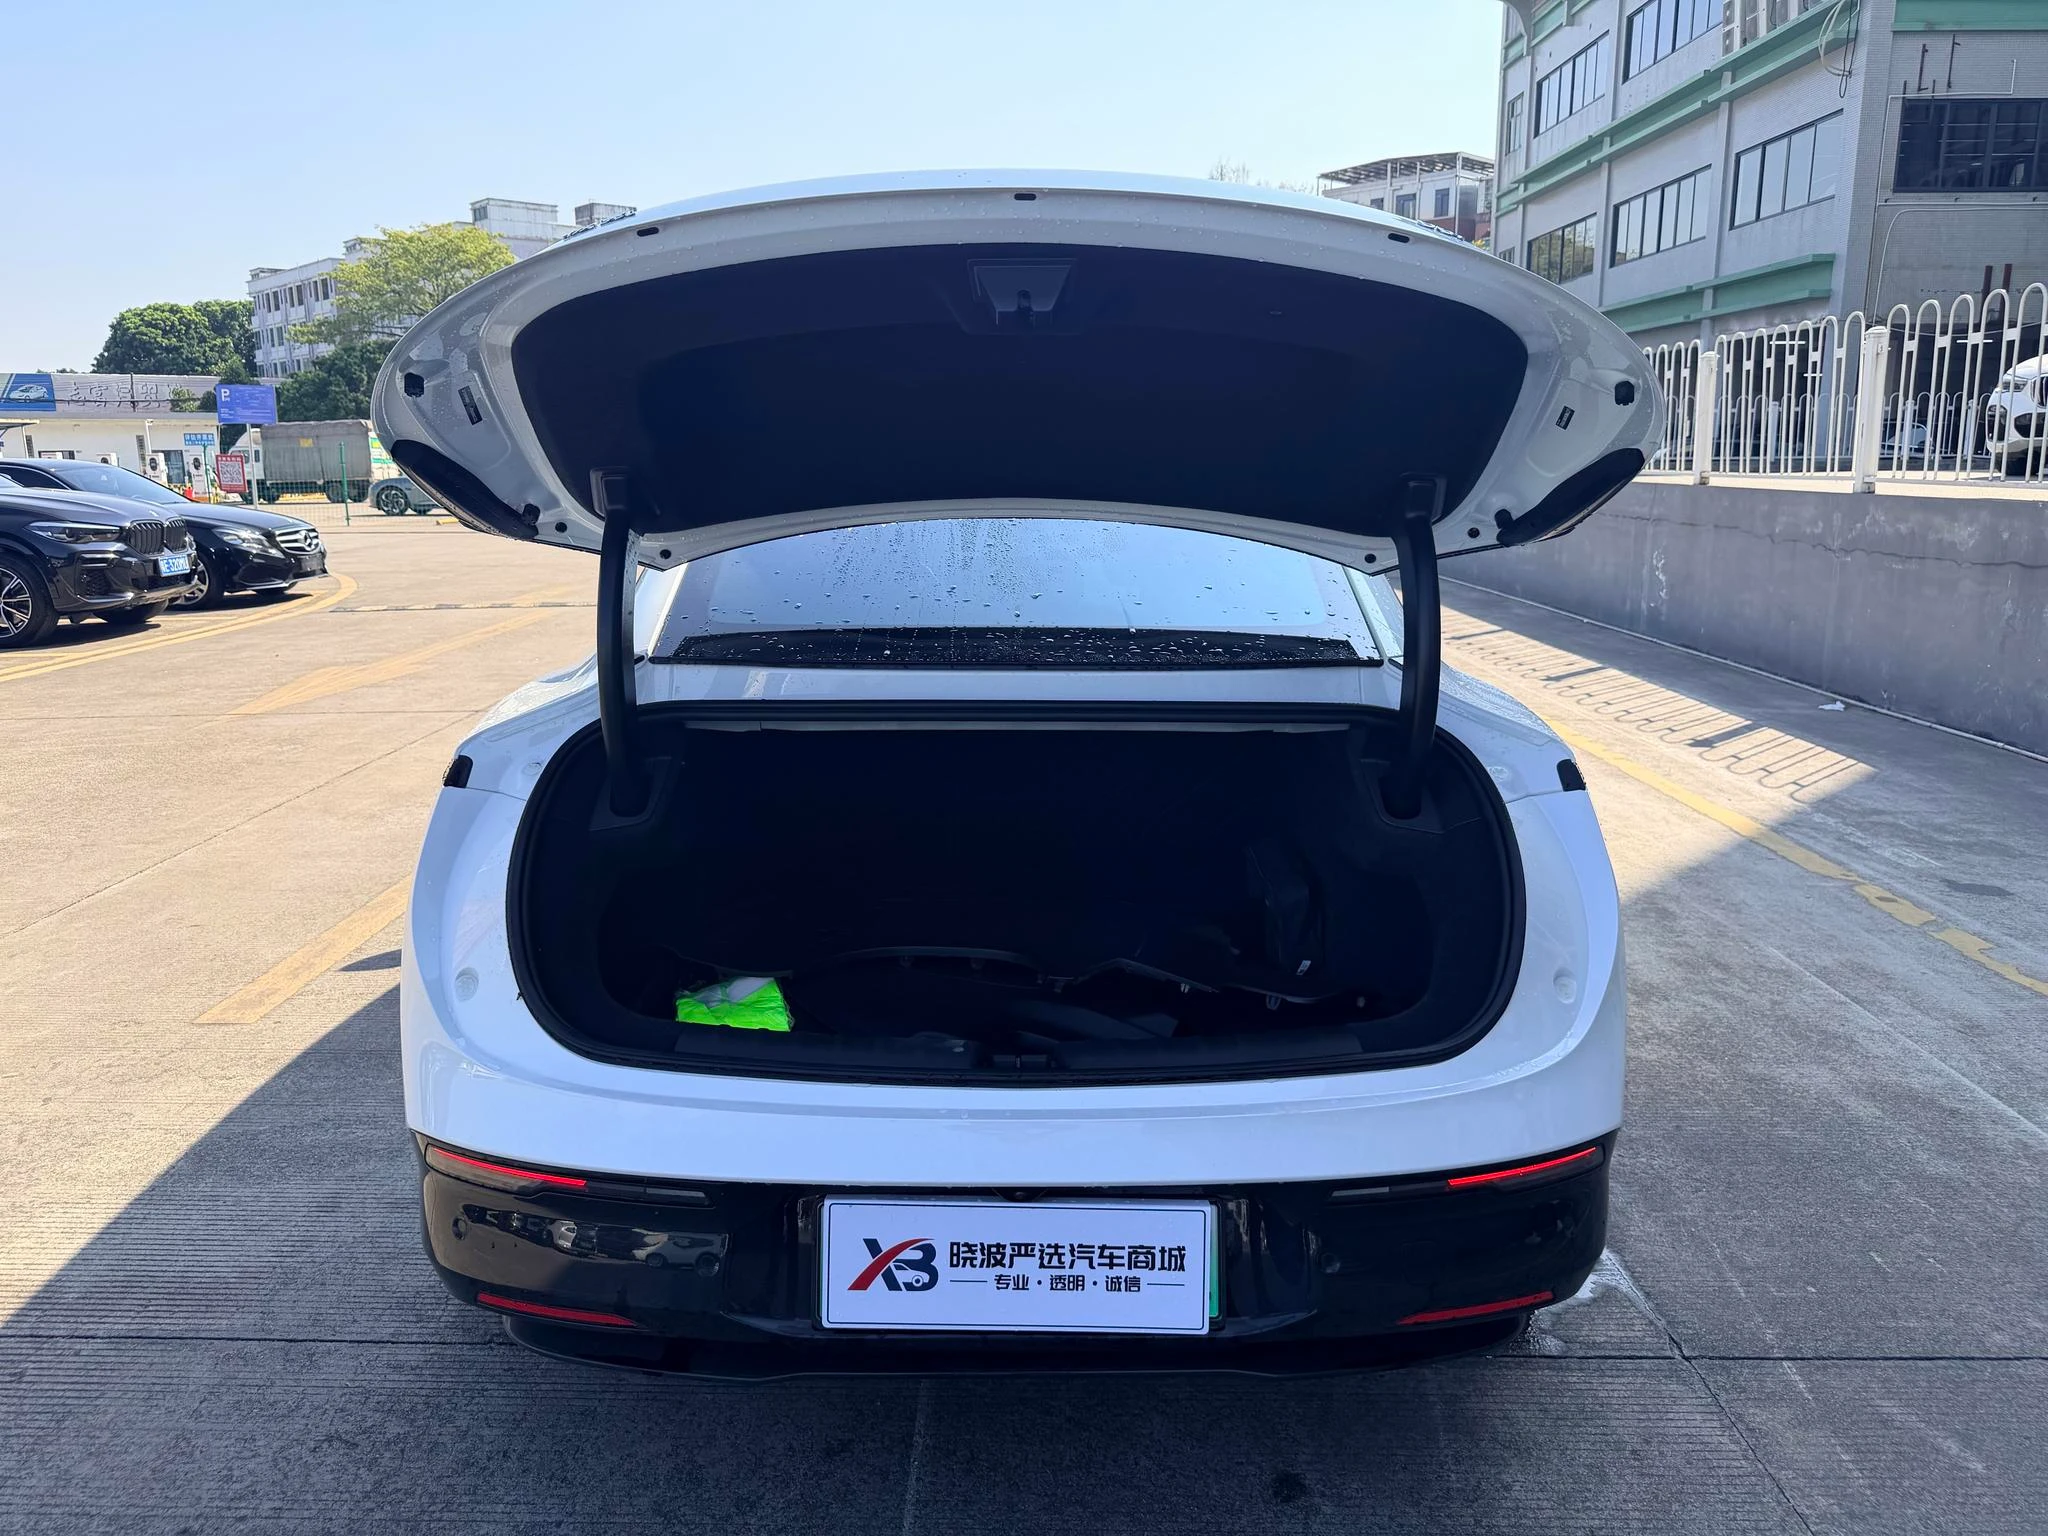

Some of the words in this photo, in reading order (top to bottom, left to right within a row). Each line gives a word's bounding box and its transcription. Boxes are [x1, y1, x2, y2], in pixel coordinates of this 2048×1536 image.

[221, 388, 230, 402] P
[847, 1237, 939, 1292] XB
[949, 1240, 1187, 1273] 晓波严选汽车商城
